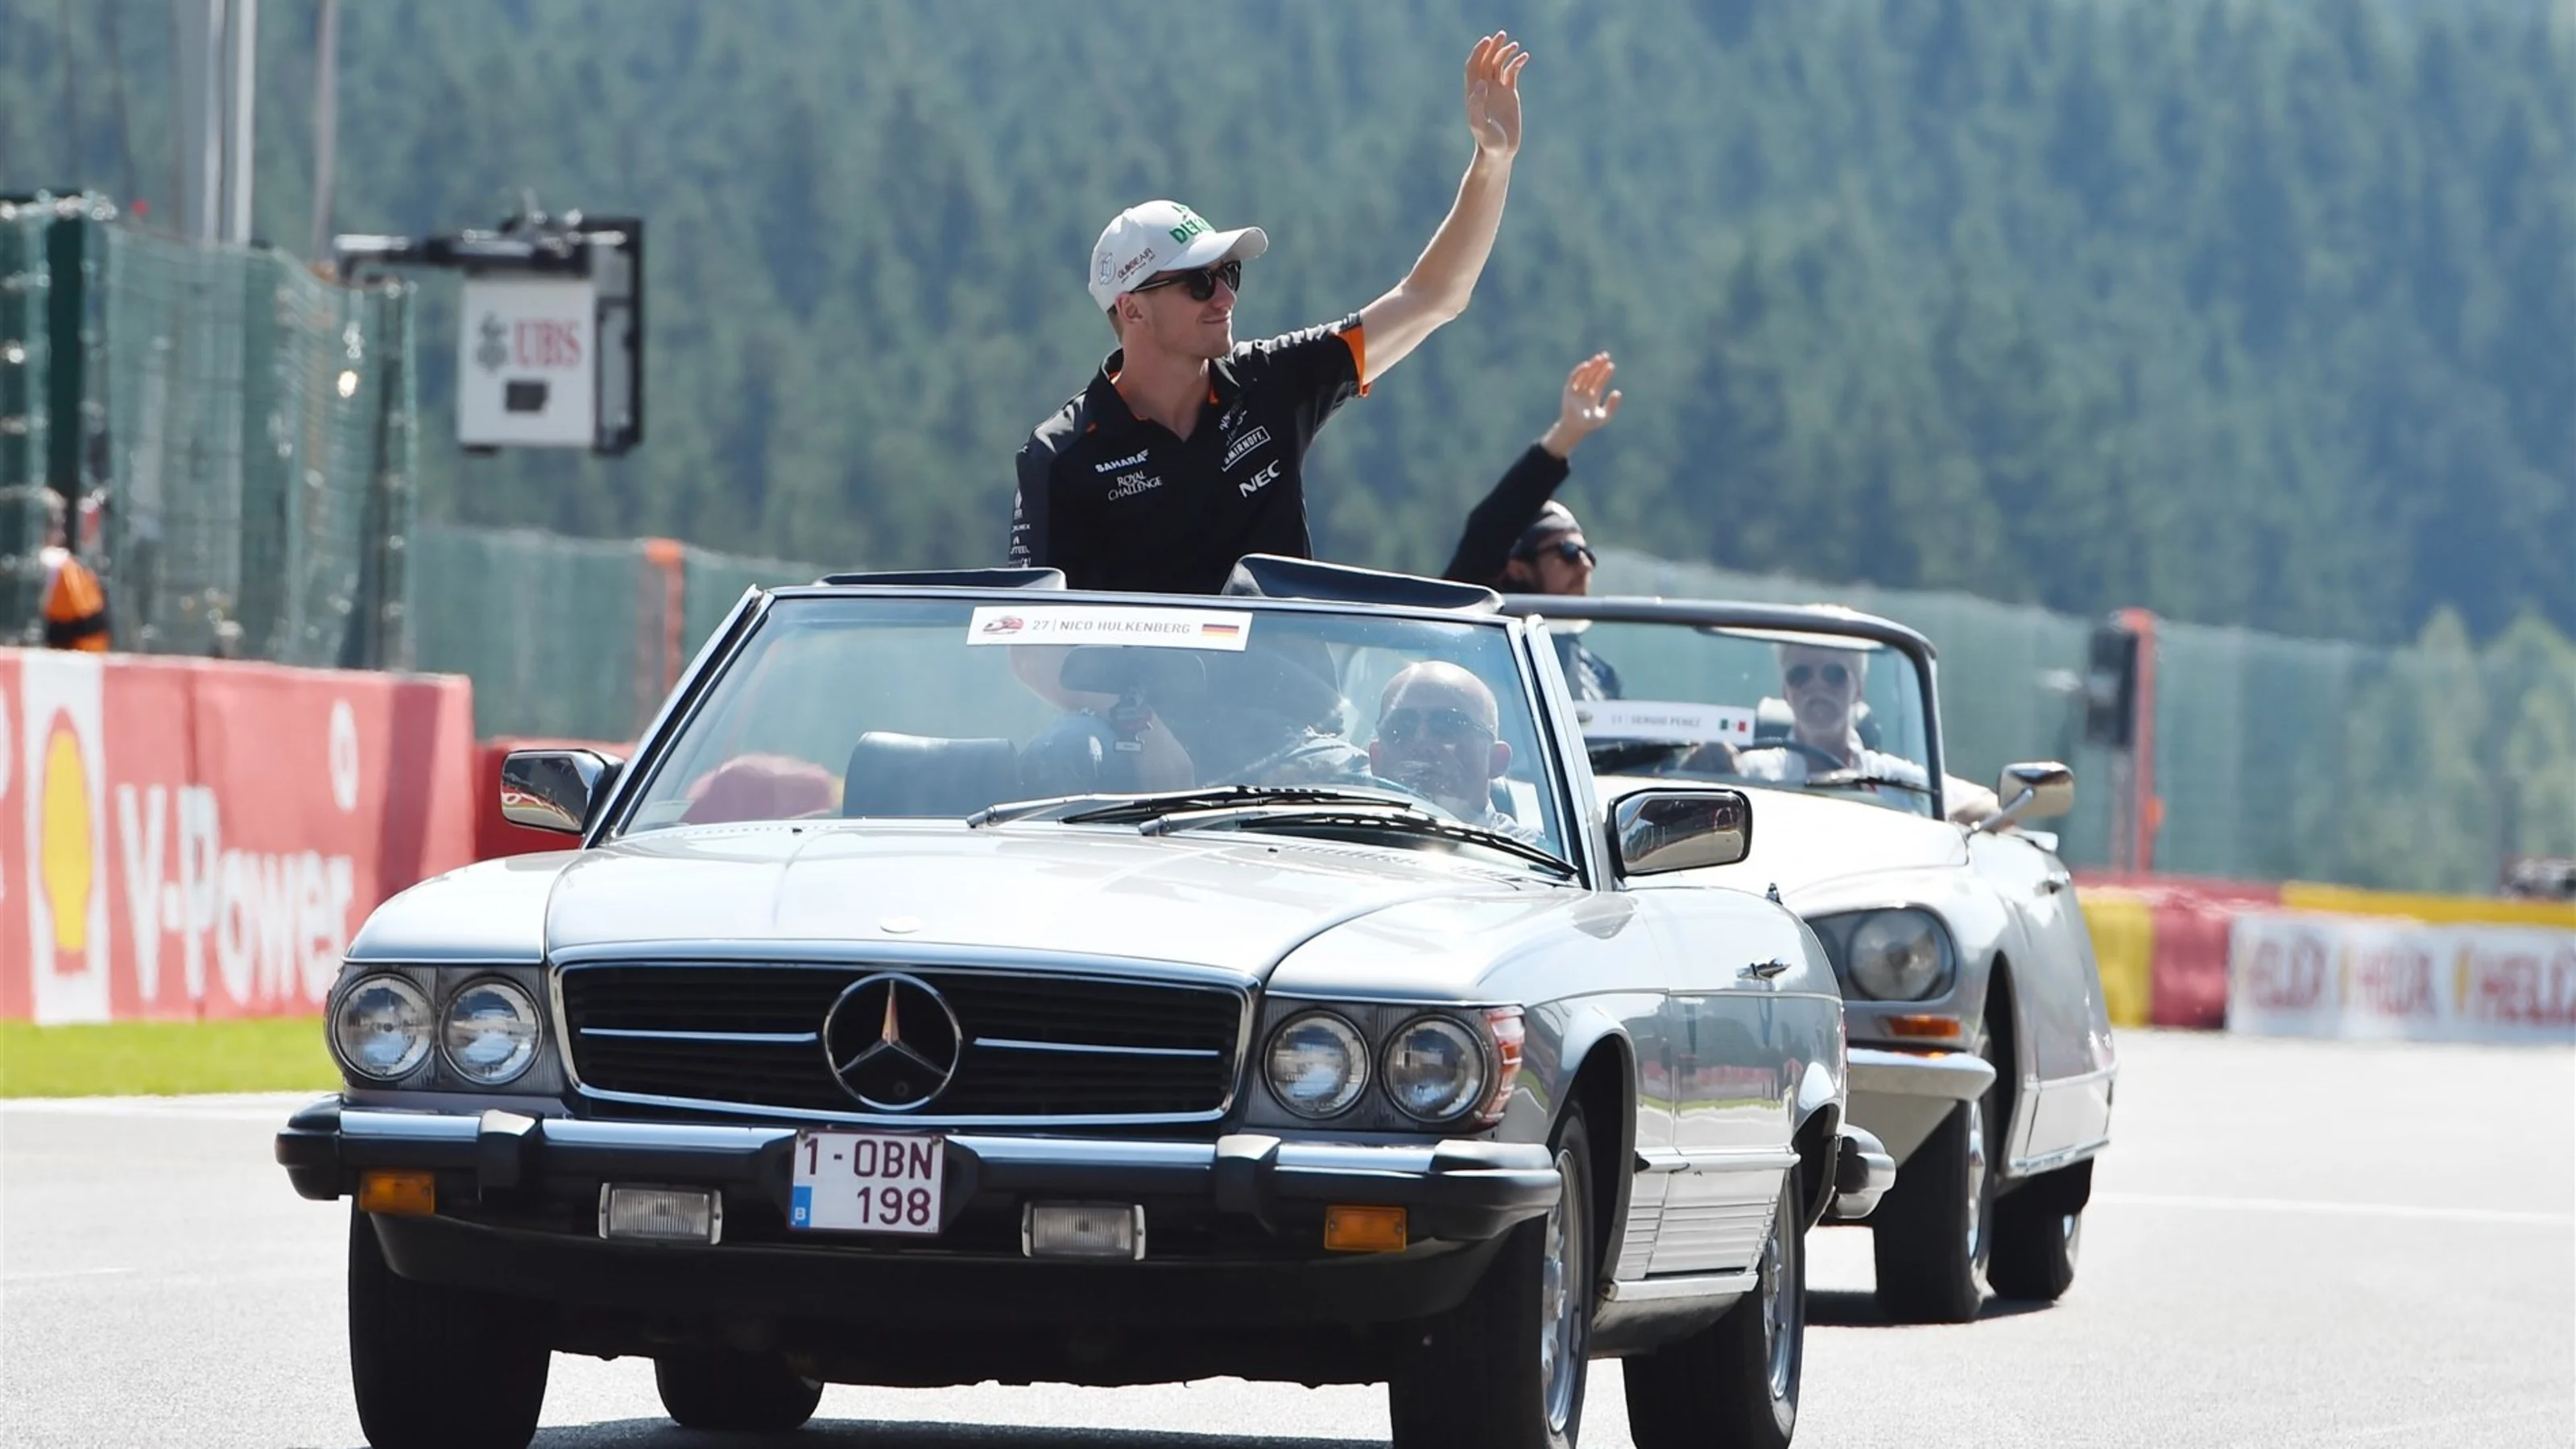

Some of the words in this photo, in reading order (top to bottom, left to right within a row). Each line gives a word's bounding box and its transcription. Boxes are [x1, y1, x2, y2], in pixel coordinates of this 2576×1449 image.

[515, 319, 582, 369] UBS
[1095, 452, 1147, 473] SAHARA
[1224, 431, 1265, 464] SMIRNOFF
[1108, 476, 1163, 501] CHALLENGE
[1117, 470, 1146, 487] ROYAL
[1238, 459, 1280, 497] NEC
[1032, 620, 1050, 631] 27
[1060, 620, 1094, 632] NICO
[1097, 621, 1192, 634] HULKENBERG
[115, 783, 355, 1006] V-Power
[857, 1186, 932, 1227] 198
